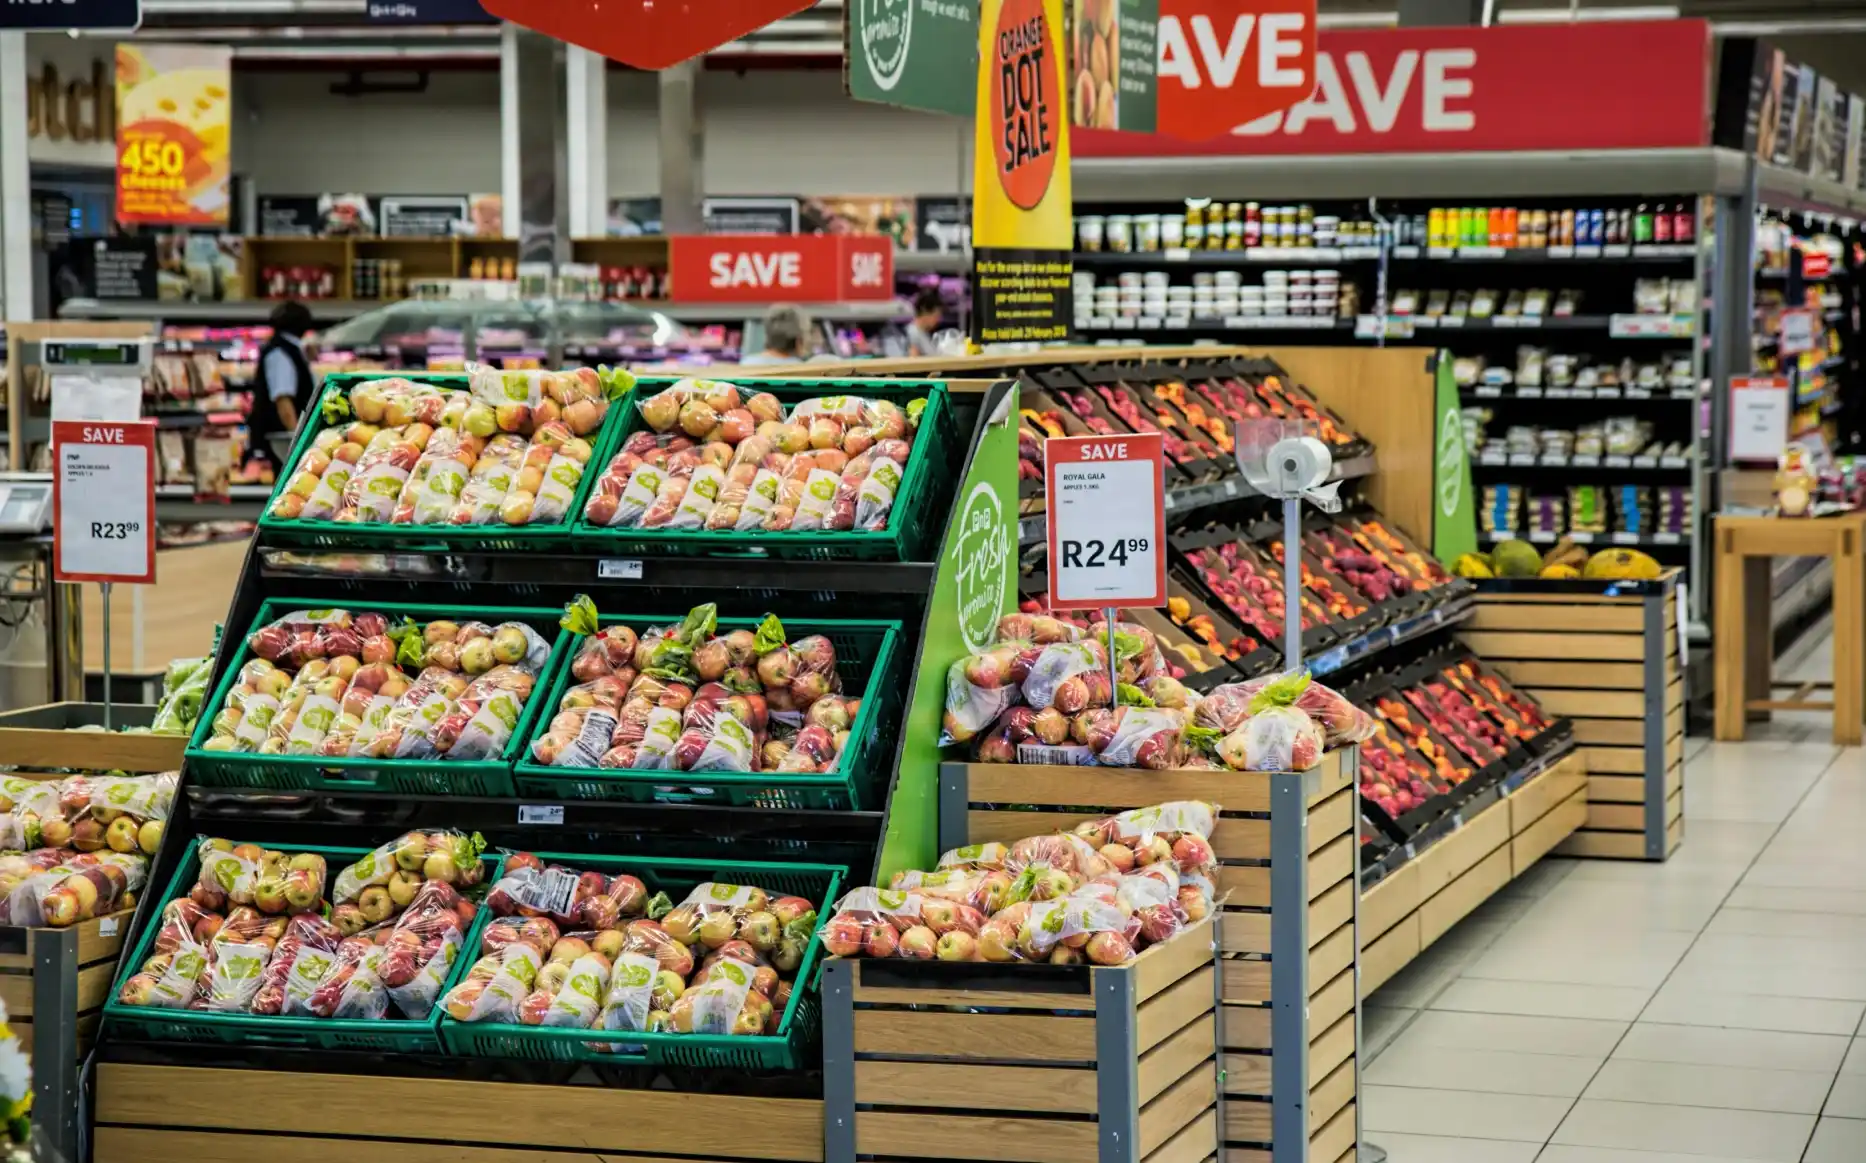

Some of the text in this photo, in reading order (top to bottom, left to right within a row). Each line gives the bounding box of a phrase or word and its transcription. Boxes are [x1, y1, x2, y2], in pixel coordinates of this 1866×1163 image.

[1000, 16, 1042, 60] ORANGE
[1157, 14, 1305, 88] AVE
[1002, 48, 1043, 120] DOT
[1230, 48, 1477, 135] AVE
[122, 140, 184, 174] 450
[1005, 104, 1050, 172] SALE
[709, 252, 802, 287] SAVE
[82, 427, 125, 443] SAVE
[1080, 443, 1128, 460] SAVE
[952, 524, 1011, 594] Fresh
